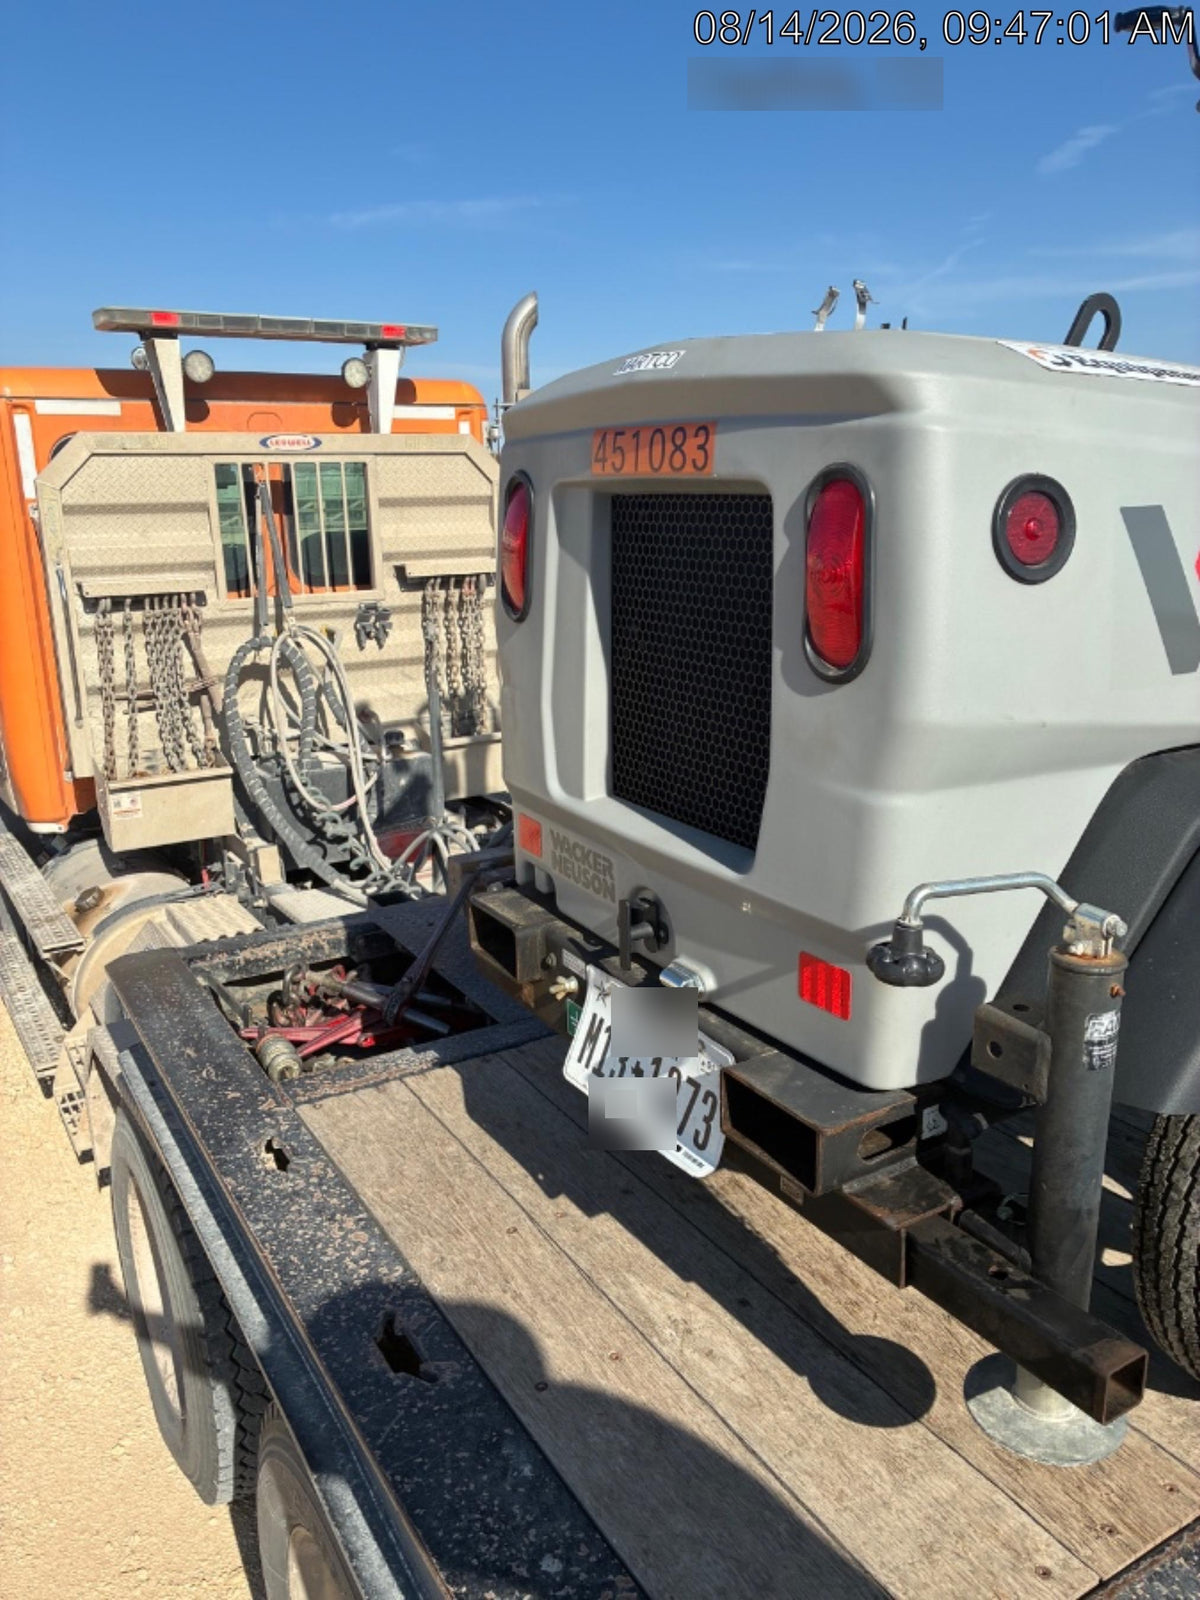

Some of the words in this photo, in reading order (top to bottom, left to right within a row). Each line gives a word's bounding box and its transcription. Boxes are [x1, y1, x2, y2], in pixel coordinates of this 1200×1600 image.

[594, 425, 710, 472] 451083
[549, 828, 614, 881] WACKER
[550, 849, 616, 904] NEUSON
